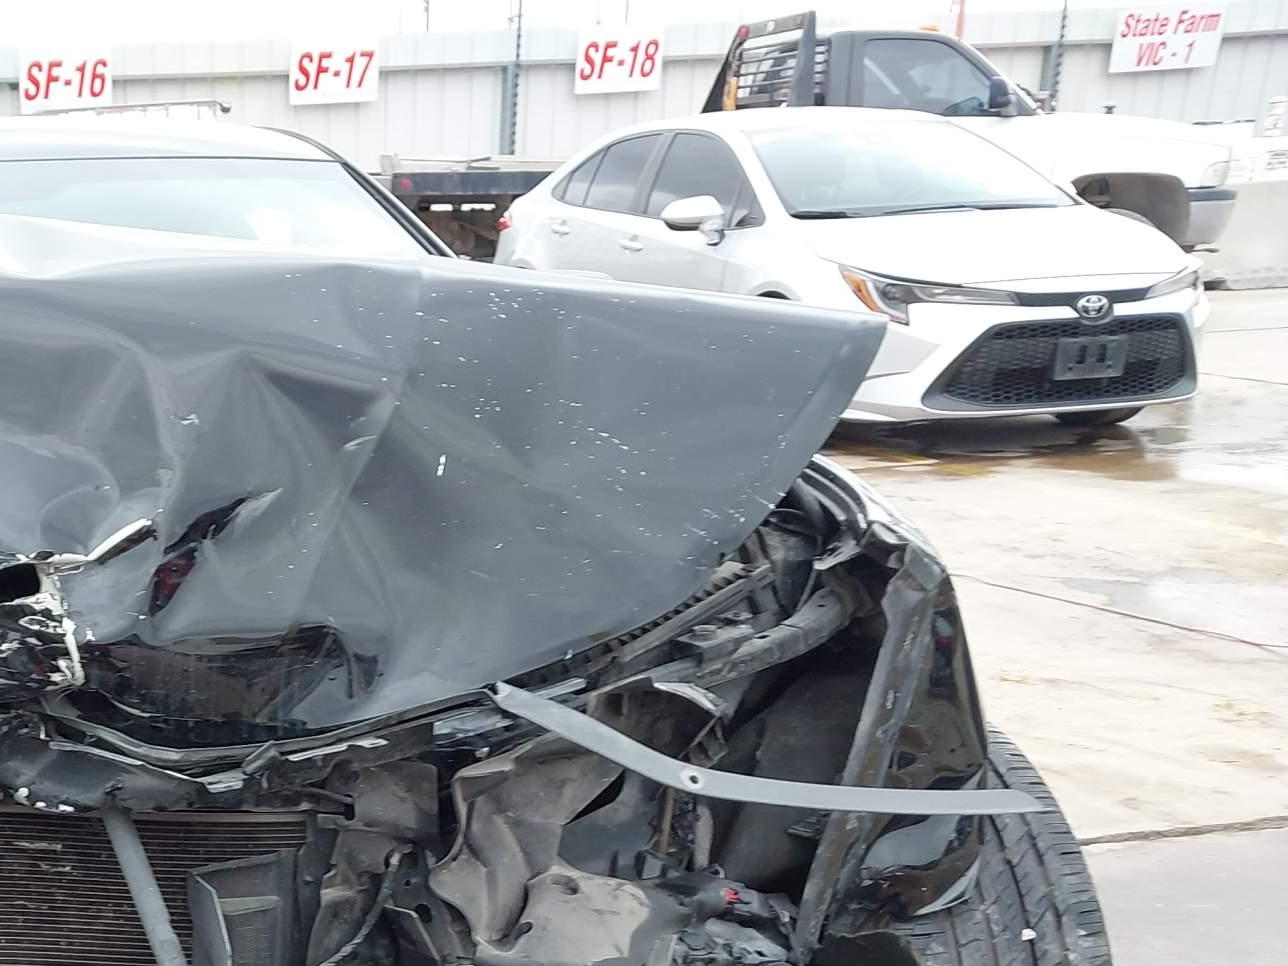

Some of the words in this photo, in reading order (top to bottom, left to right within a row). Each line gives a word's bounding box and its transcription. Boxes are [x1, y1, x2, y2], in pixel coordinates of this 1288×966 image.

[1120, 12, 1169, 38] State
[1173, 9, 1221, 34] Farm
[294, 49, 376, 91] SF-17
[579, 39, 659, 80] SF-18
[1135, 41, 1167, 67] VIC
[1184, 39, 1196, 64] 1
[24, 59, 107, 100] SF-16
